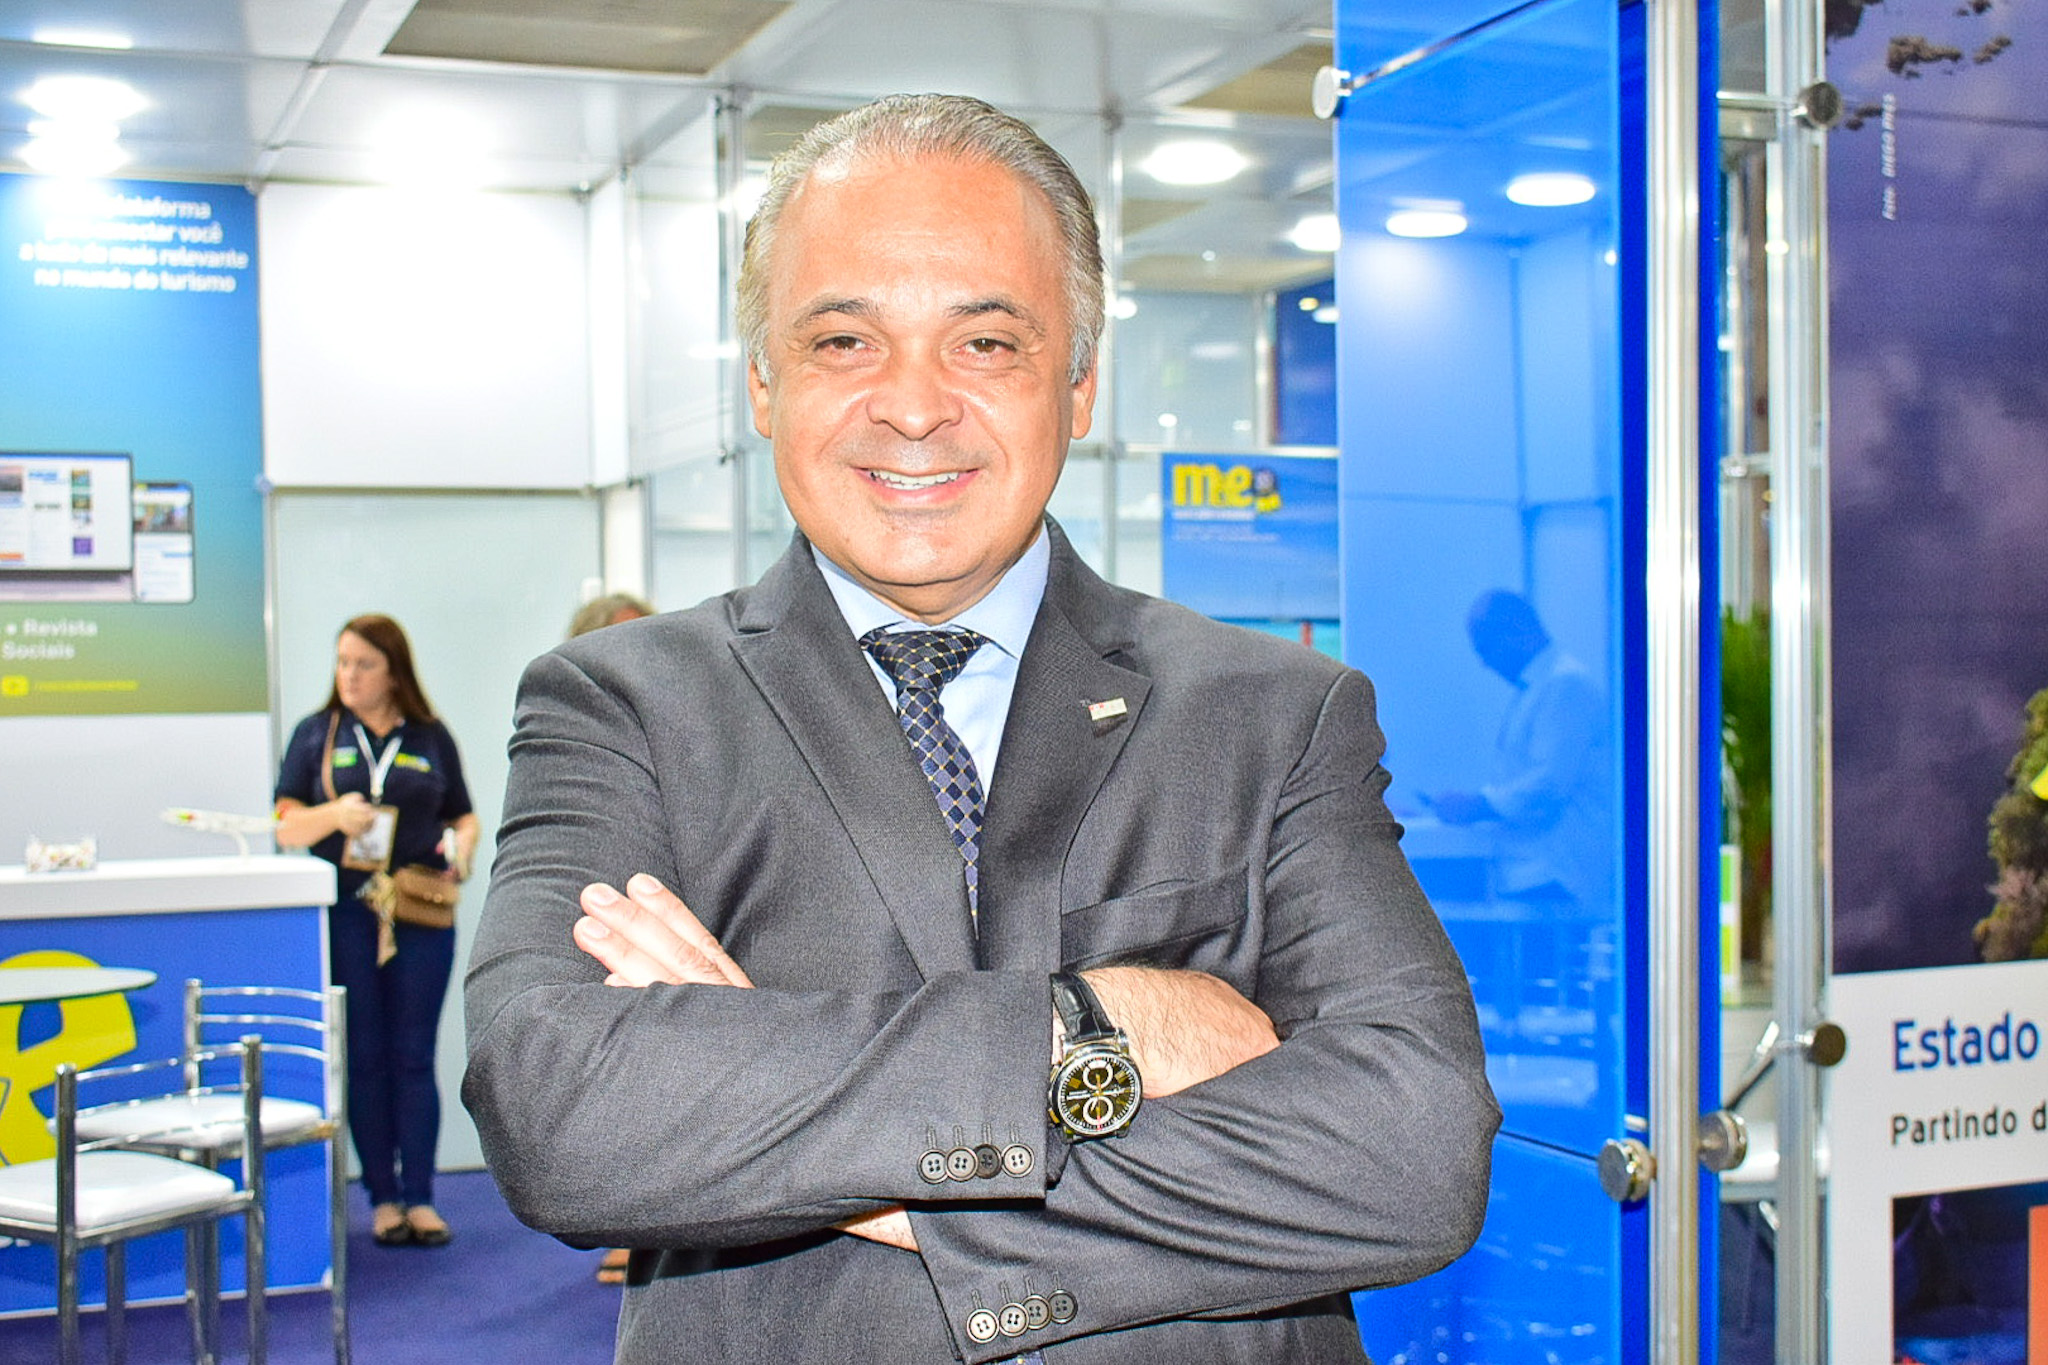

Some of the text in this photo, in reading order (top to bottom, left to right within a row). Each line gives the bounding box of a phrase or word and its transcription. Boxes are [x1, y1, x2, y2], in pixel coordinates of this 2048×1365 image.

[159, 246, 249, 269] relevante
[160, 270, 237, 292] turismo
[23, 618, 98, 637] Revista
[2, 641, 76, 660] Sociais
[1893, 1010, 2039, 1071] Estado
[1891, 1105, 2017, 1145] Partindo
